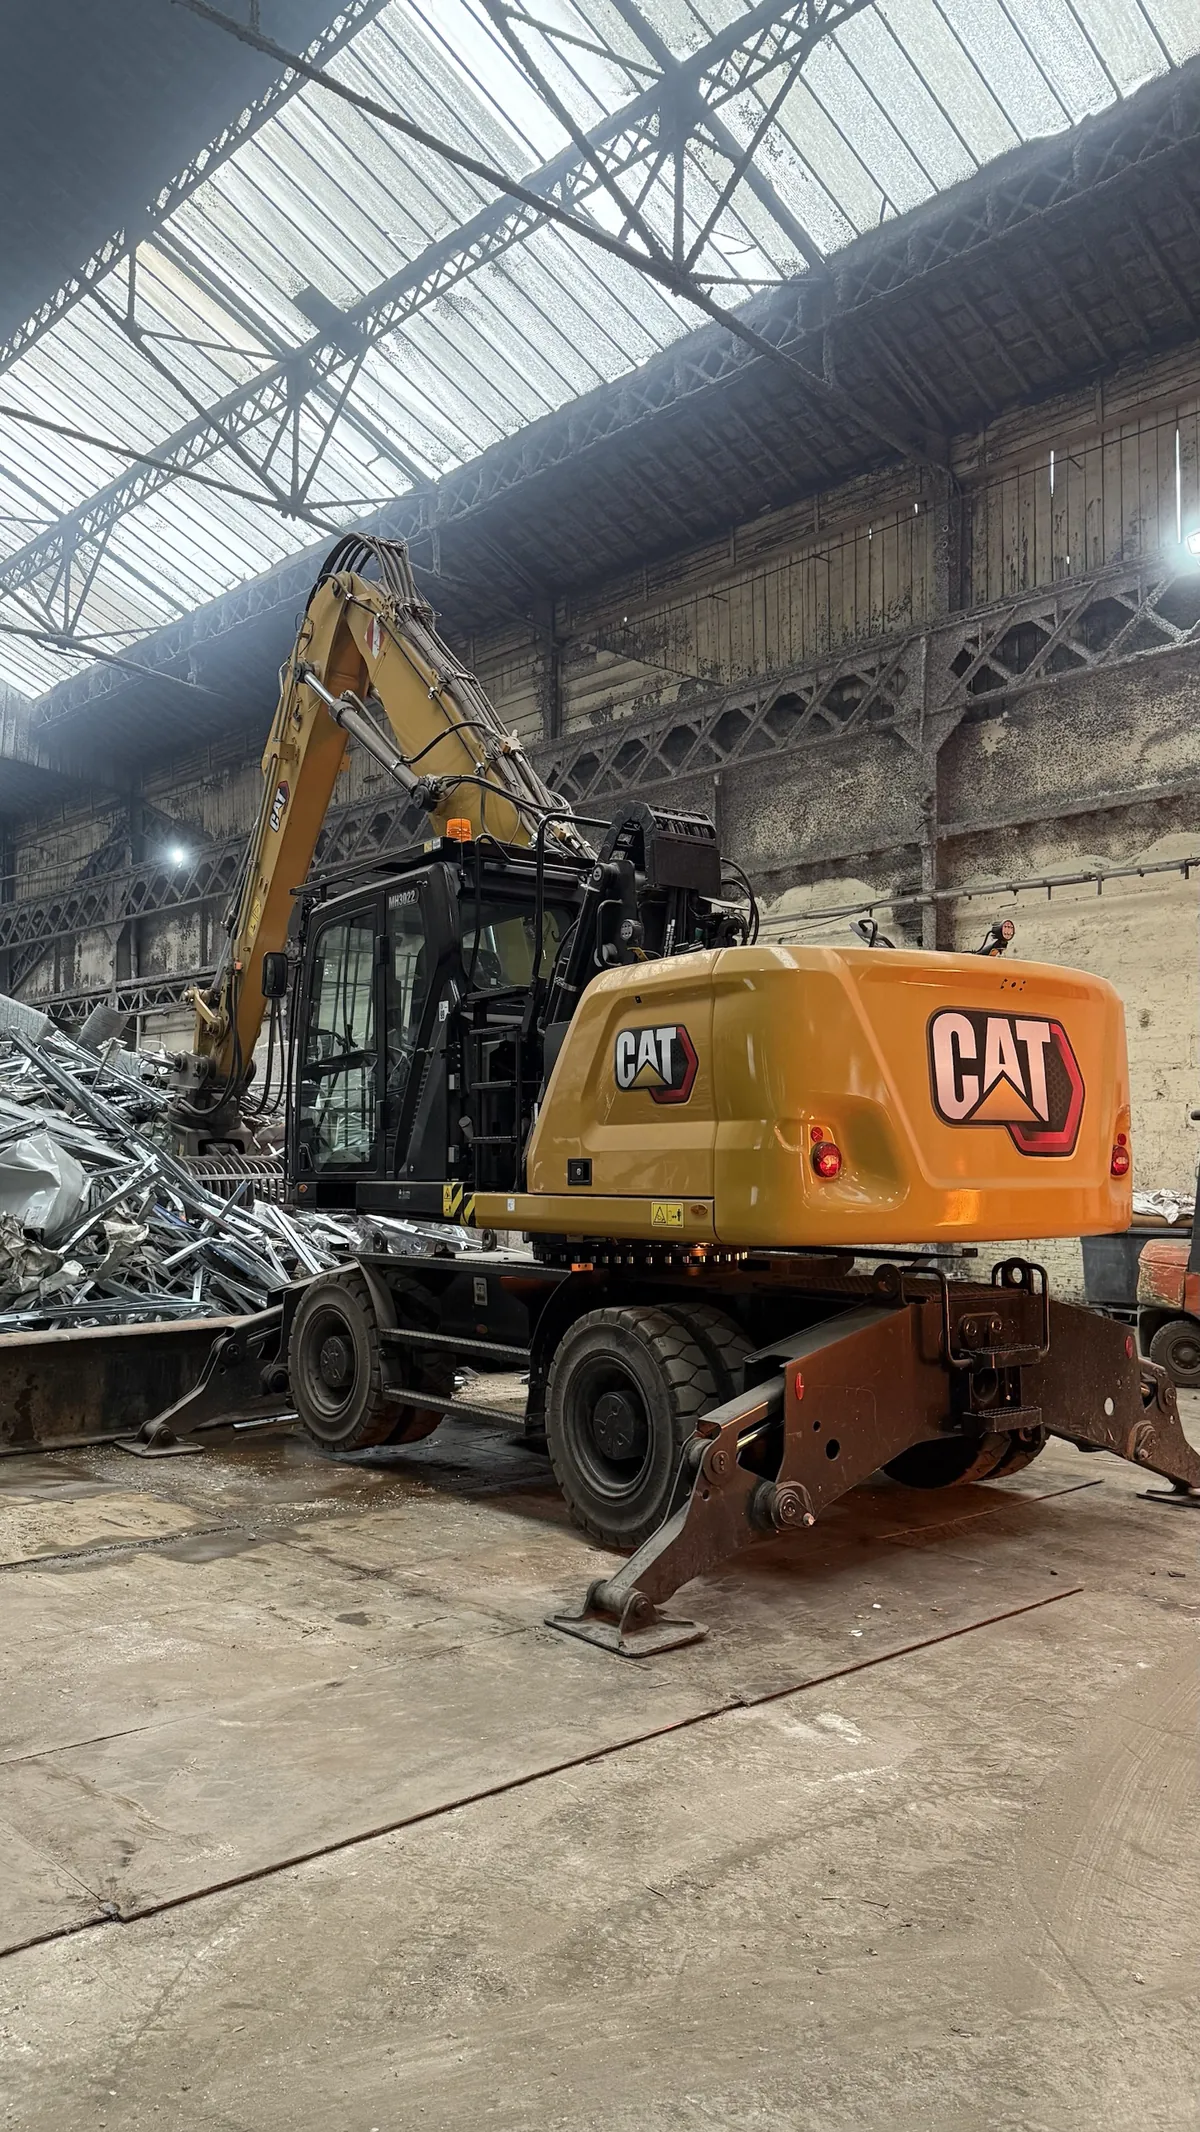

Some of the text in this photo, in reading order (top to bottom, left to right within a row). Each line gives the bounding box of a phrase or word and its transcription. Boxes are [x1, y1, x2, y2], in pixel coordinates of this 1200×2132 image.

[269, 787, 286, 832] CAT
[388, 890, 415, 909] MH3022
[616, 1026, 677, 1088] CAT
[932, 1012, 1051, 1122] CAT
